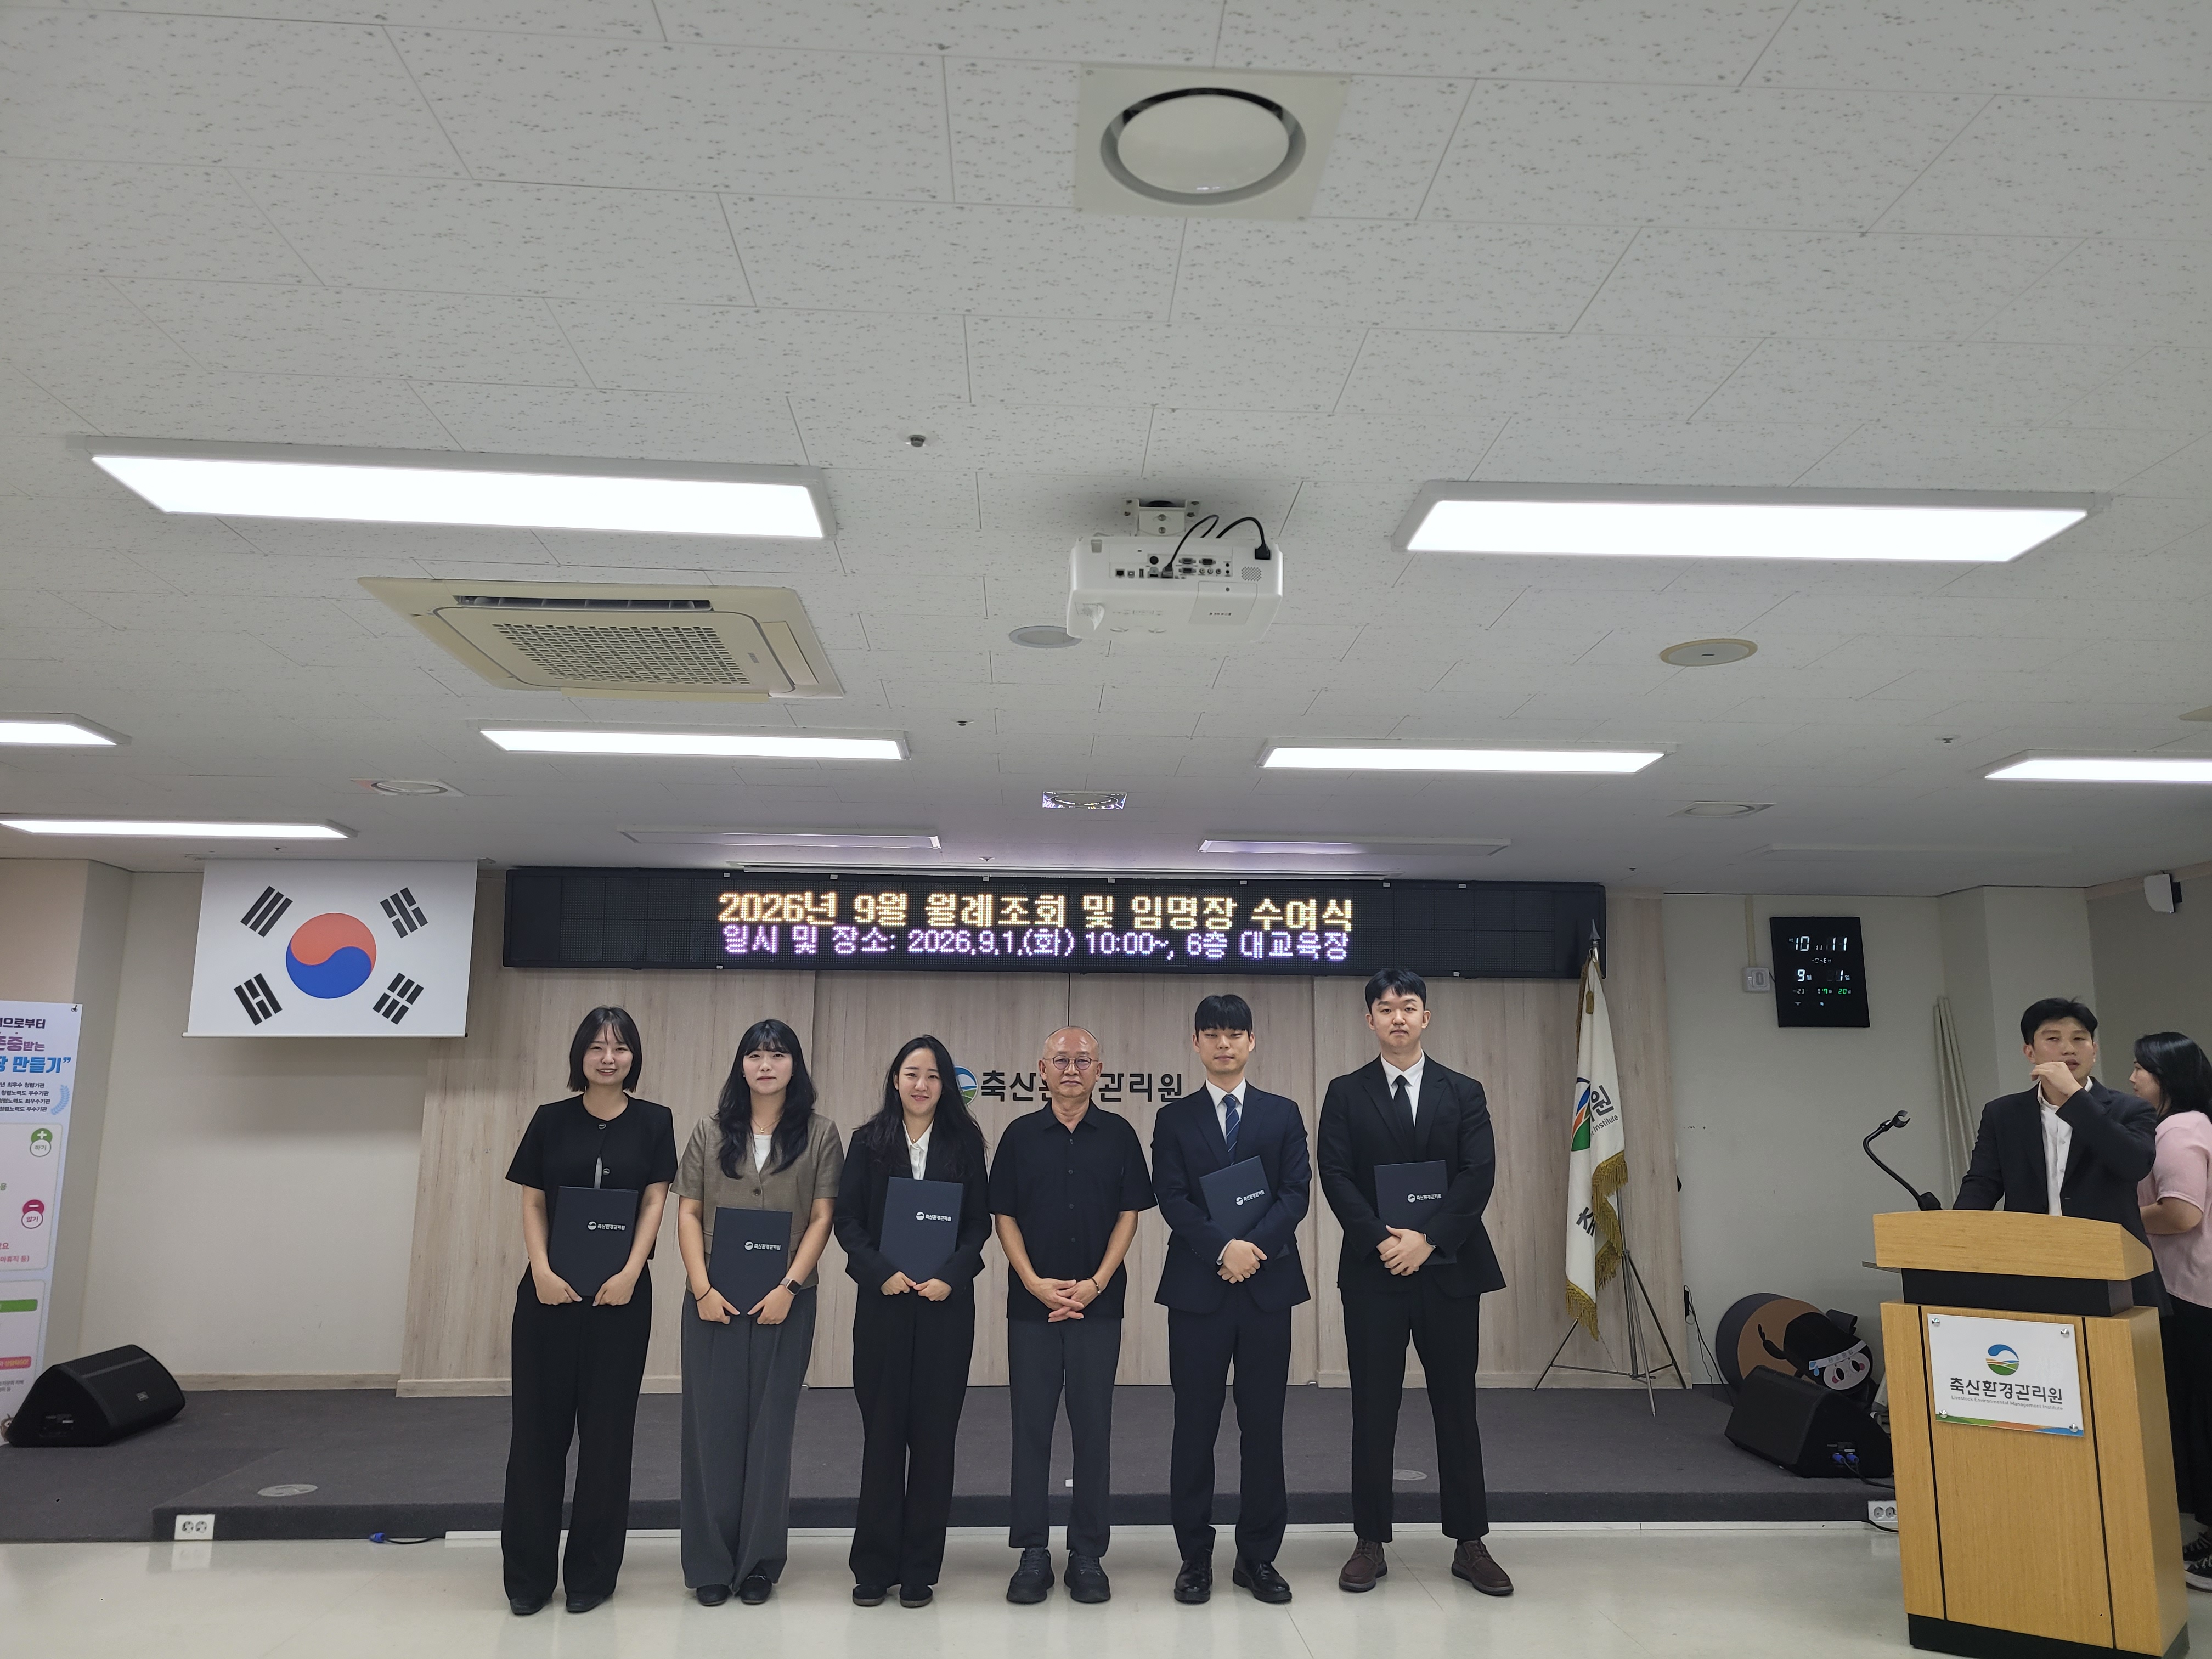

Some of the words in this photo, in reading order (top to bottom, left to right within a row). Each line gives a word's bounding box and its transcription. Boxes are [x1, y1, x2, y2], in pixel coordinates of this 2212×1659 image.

[718, 891, 837, 926] 2026년
[853, 892, 908, 927] 9월
[925, 893, 1066, 928] 월례조회
[1083, 895, 1113, 929] 및
[1131, 895, 1238, 930] 임명장
[1251, 898, 1352, 932] 수여식
[723, 924, 778, 955] 일시
[791, 925, 817, 955] 및
[832, 926, 896, 955] 장소:
[1187, 931, 1228, 959] 6층
[1240, 930, 1349, 961] 대교육장
[981, 1070, 1182, 1102] 축산관리원
[1593, 1115, 1619, 1132] Institute
[1950, 1377, 2063, 1404] 축산환경관리원
[1974, 1397, 2009, 1406] Environmental
